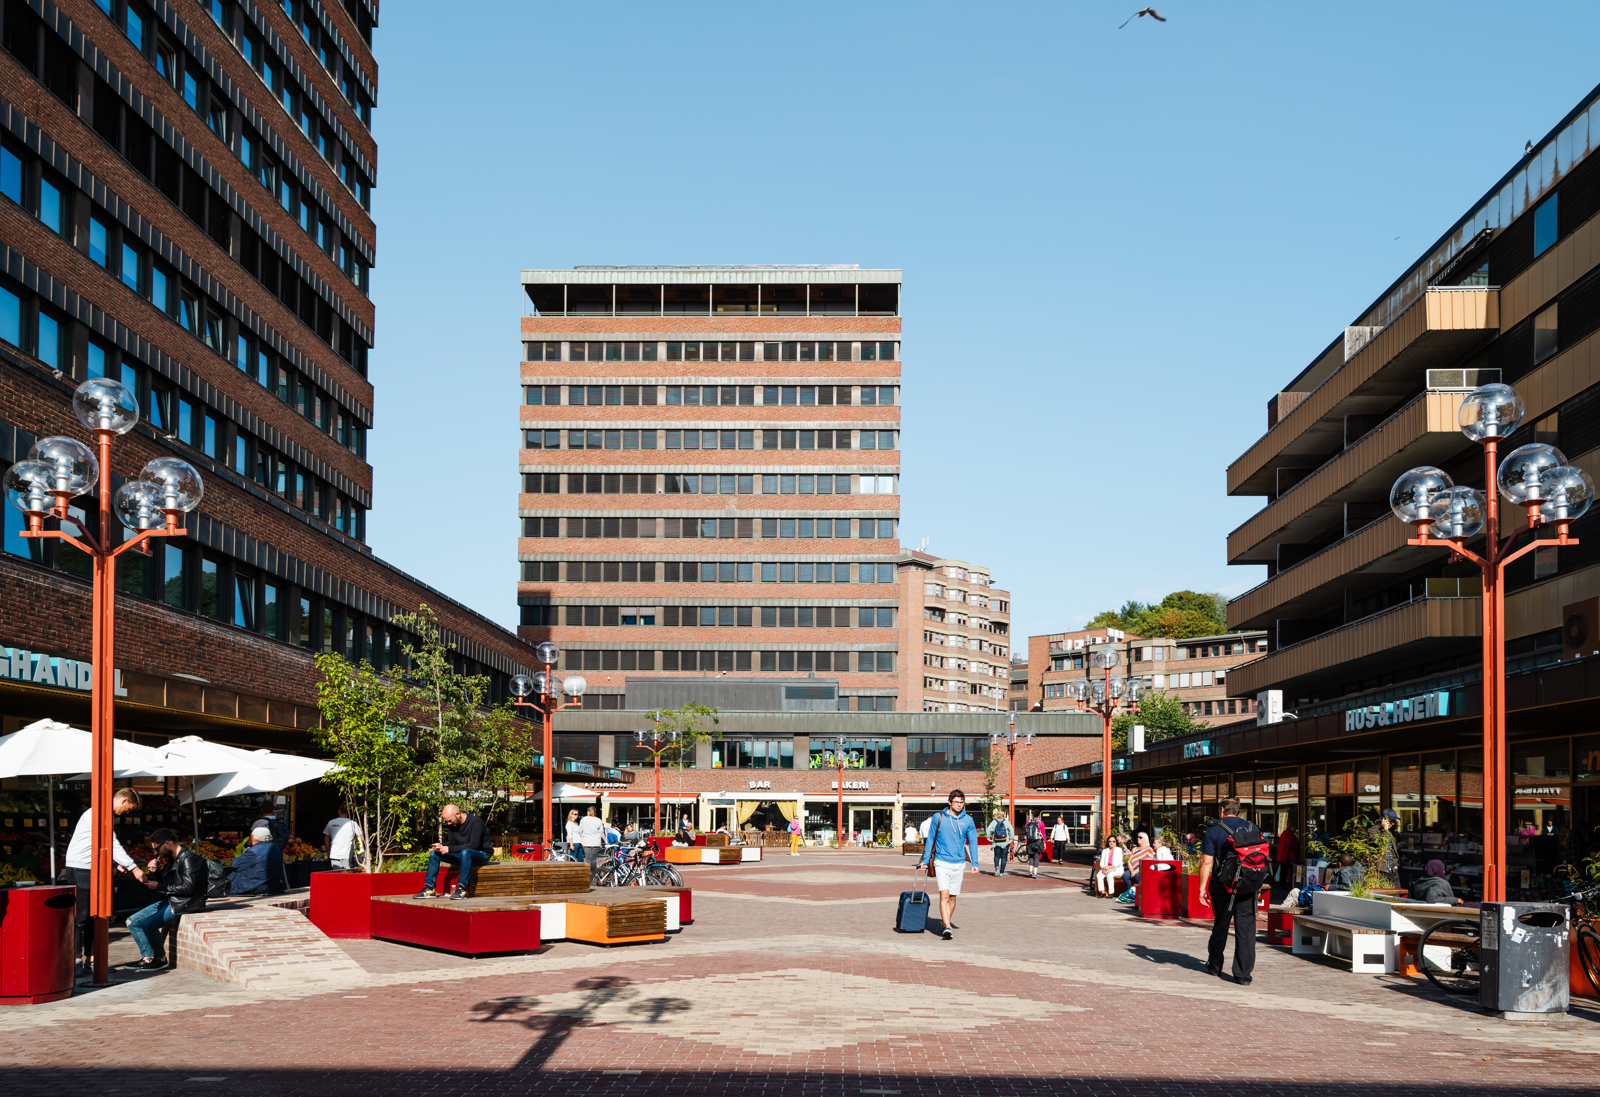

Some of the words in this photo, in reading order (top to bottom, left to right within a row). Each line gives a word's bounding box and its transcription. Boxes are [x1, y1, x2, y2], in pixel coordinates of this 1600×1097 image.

[0, 645, 128, 697] HANDL
[1346, 705, 1375, 731] HUS
[1377, 702, 1390, 727] &
[1393, 692, 1440, 723] HJEM
[1183, 740, 1205, 759] KIOSK
[749, 780, 771, 789] BAR
